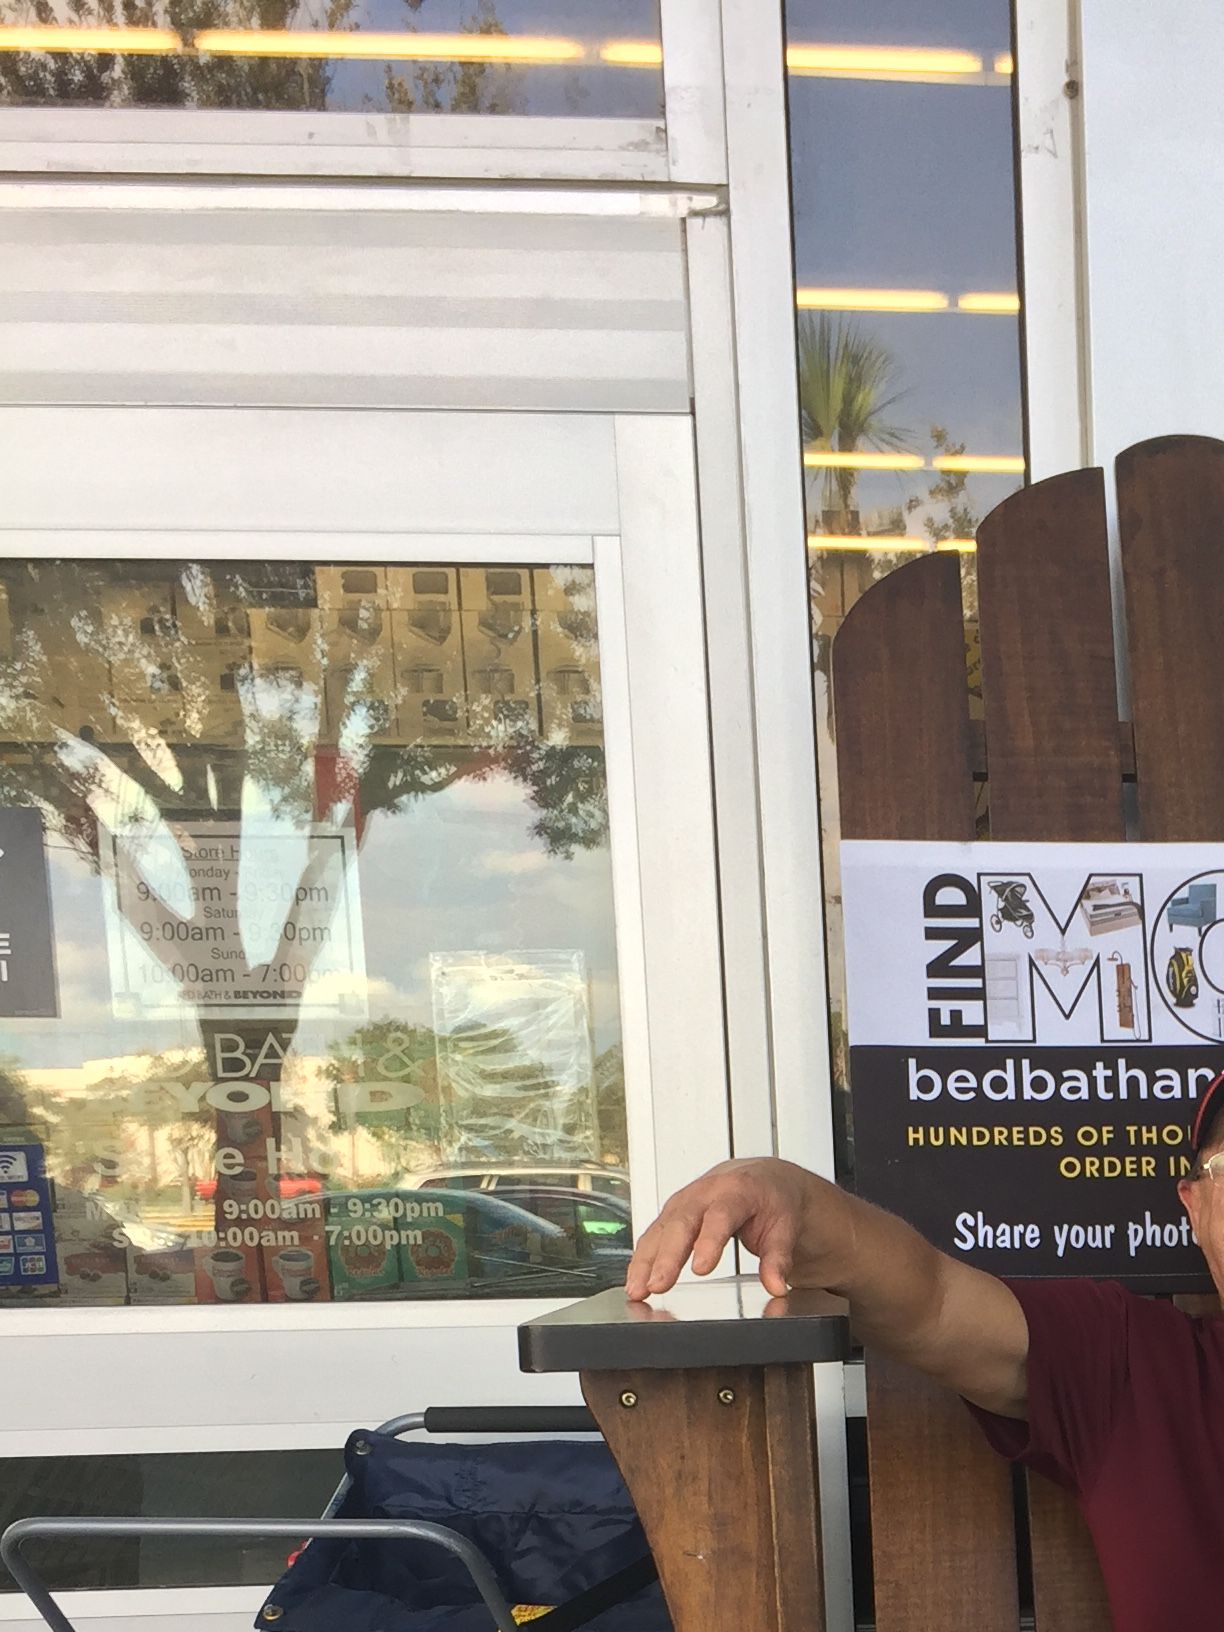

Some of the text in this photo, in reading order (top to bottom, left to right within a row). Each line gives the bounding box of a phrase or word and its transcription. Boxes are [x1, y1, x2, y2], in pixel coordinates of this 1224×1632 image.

[140, 921, 225, 941] 9:00am
[923, 872, 986, 1039] FIND
[233, 990, 302, 999] BEYOND
[376, 1032, 425, 1077] &
[907, 1126, 1064, 1147] HUNDREDS
[1076, 1125, 1114, 1146] OF
[1059, 1156, 1157, 1178] ORDER
[223, 1198, 321, 1219] 9:00am
[347, 1197, 444, 1222] 9:30pm
[324, 1225, 423, 1250] 7:00pm
[953, 1211, 1041, 1251] Share
[1053, 1222, 1116, 1258] your
